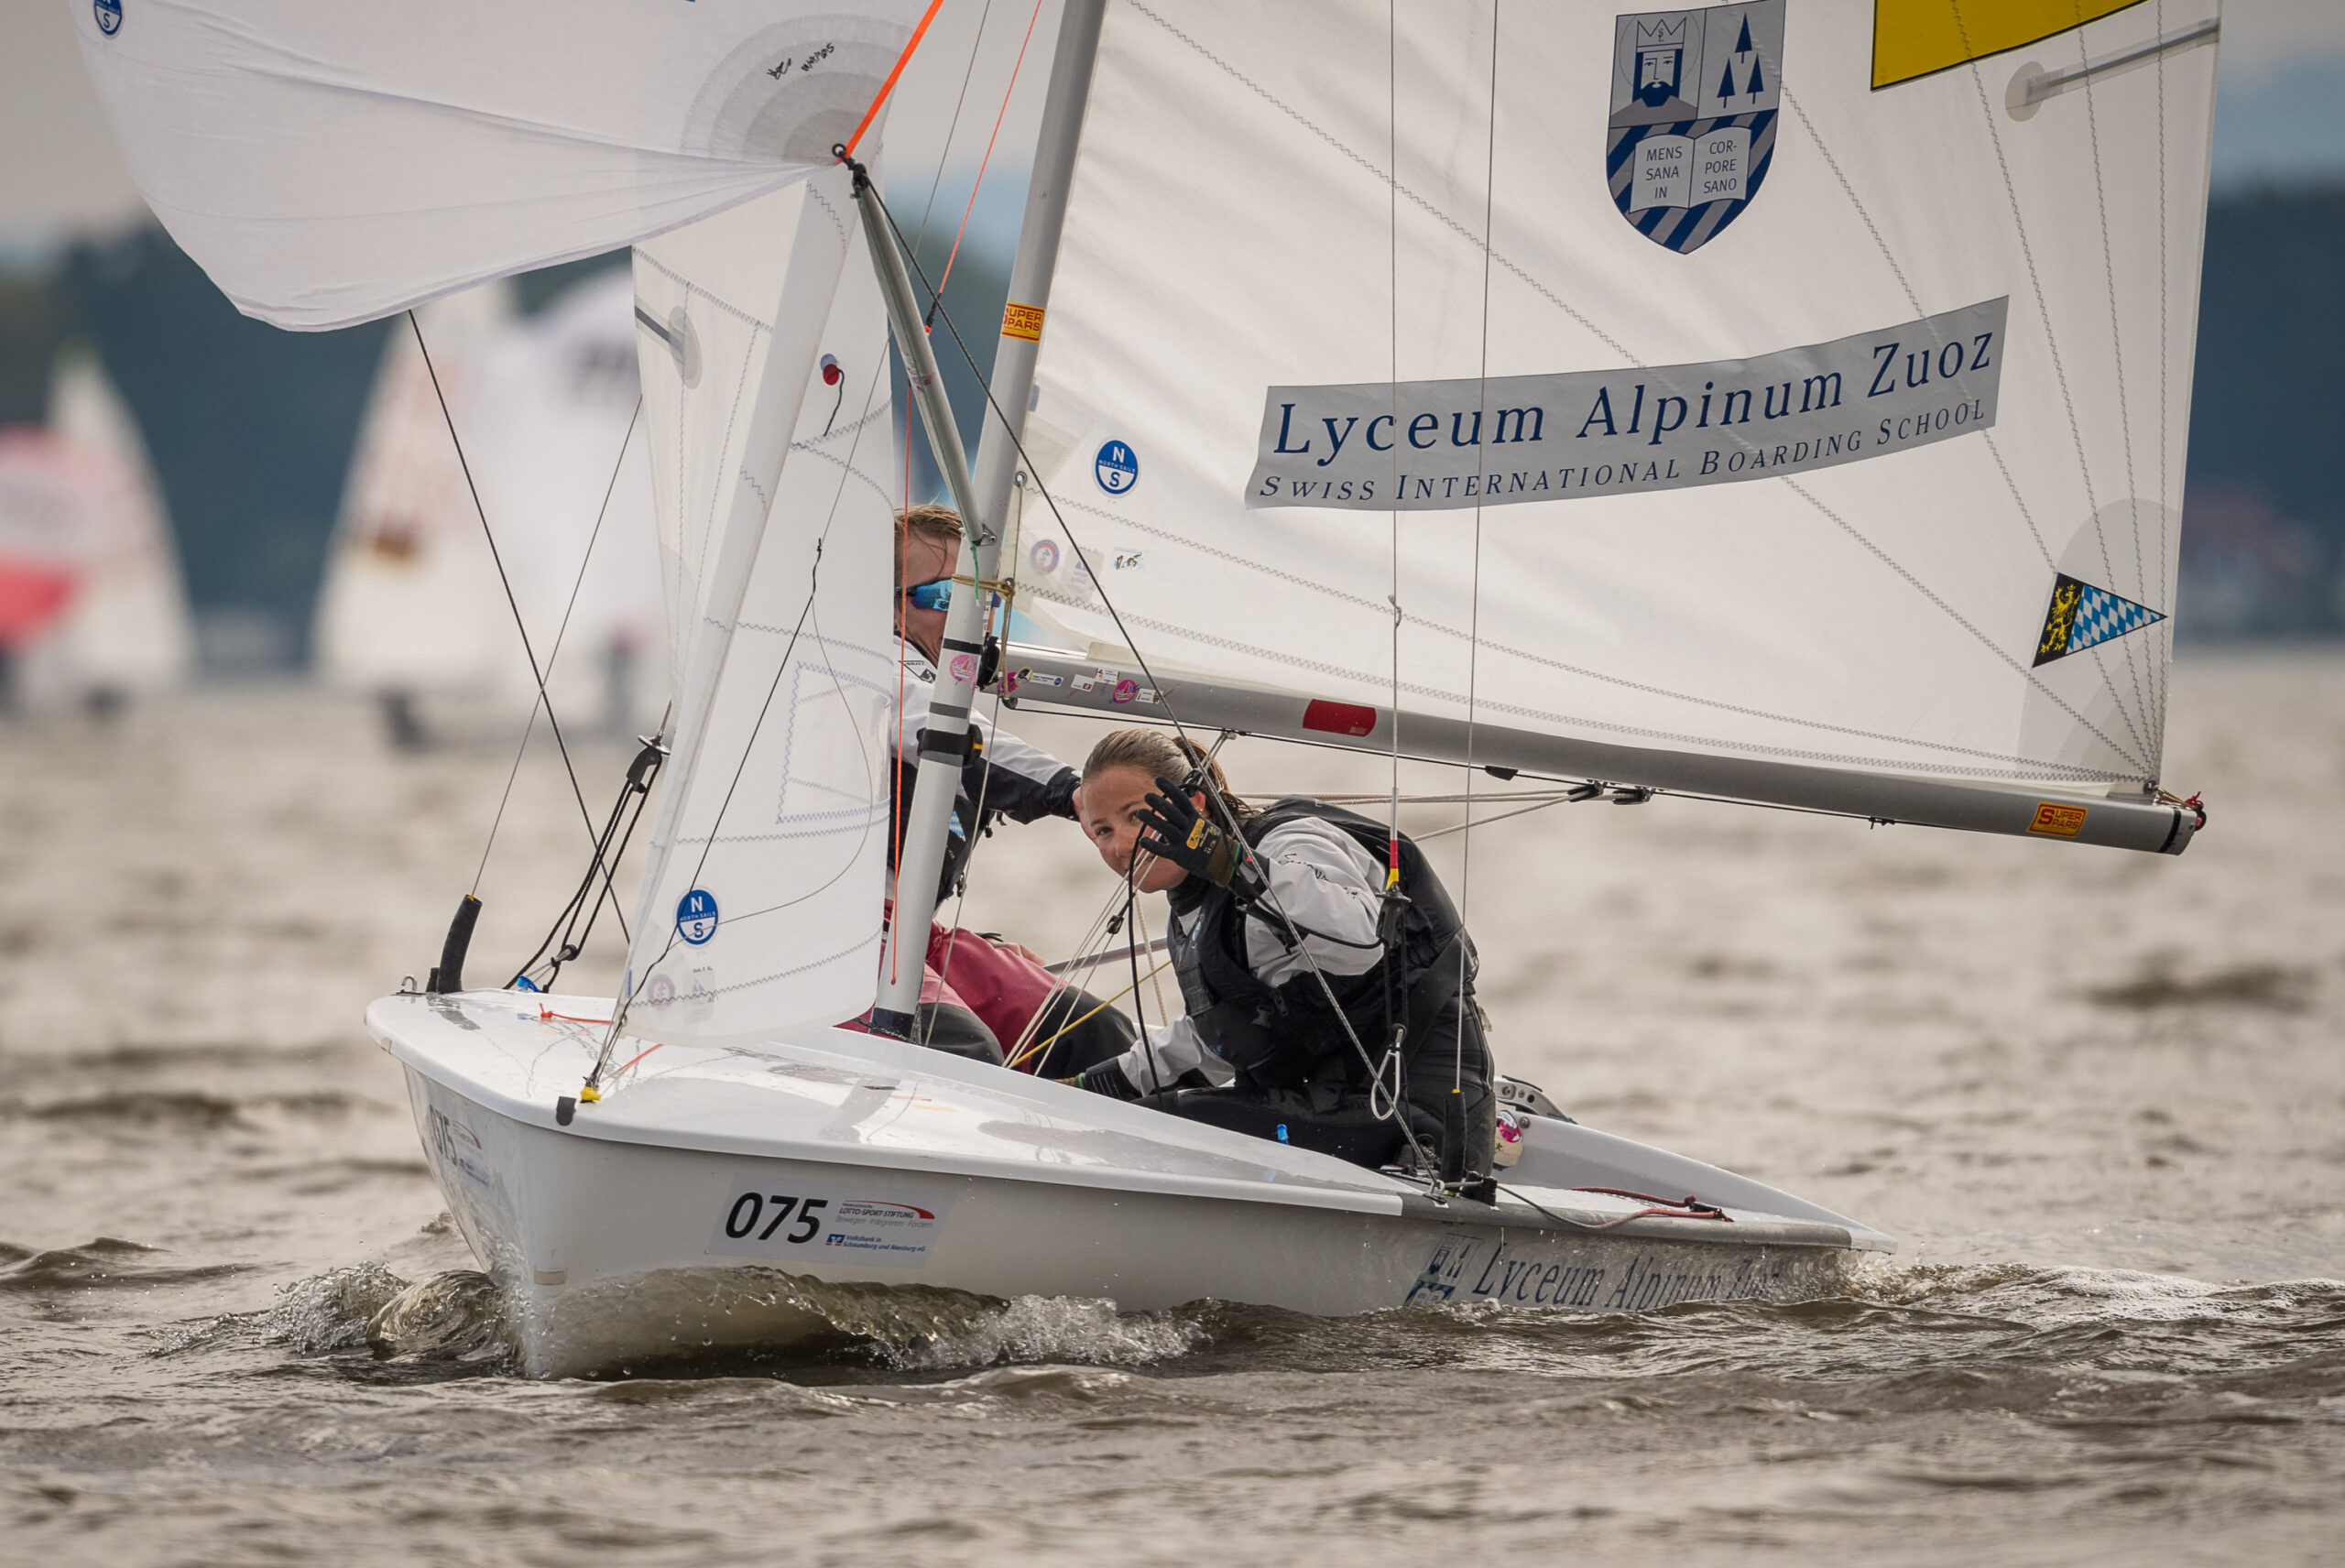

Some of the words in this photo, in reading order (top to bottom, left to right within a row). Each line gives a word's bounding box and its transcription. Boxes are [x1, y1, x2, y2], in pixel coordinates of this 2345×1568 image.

[1646, 146, 1683, 161] MENS
[1709, 140, 1738, 154] COR-
[1645, 166, 1680, 180] SANA
[1705, 158, 1737, 174] PORE
[1654, 187, 1667, 199] IN
[1703, 178, 1737, 193] SANO
[1274, 403, 1544, 467] Lyceum
[1576, 371, 1843, 445] Alpinum
[1867, 332, 1993, 398] Zuoz
[1113, 446, 1125, 463] N
[1260, 476, 1375, 500] SWISS
[1396, 459, 1681, 500] INTERNATIONAL
[1700, 430, 1862, 475] BOARDING
[1876, 399, 1985, 445] SCHOOL
[1109, 472, 1120, 487] S
[691, 896, 704, 912] N
[693, 922, 704, 938] S
[429, 1105, 457, 1166] 075
[725, 1192, 828, 1244] 075
[1472, 1243, 1606, 1308] Lyceum
[1605, 1256, 1722, 1312] Alpinum
